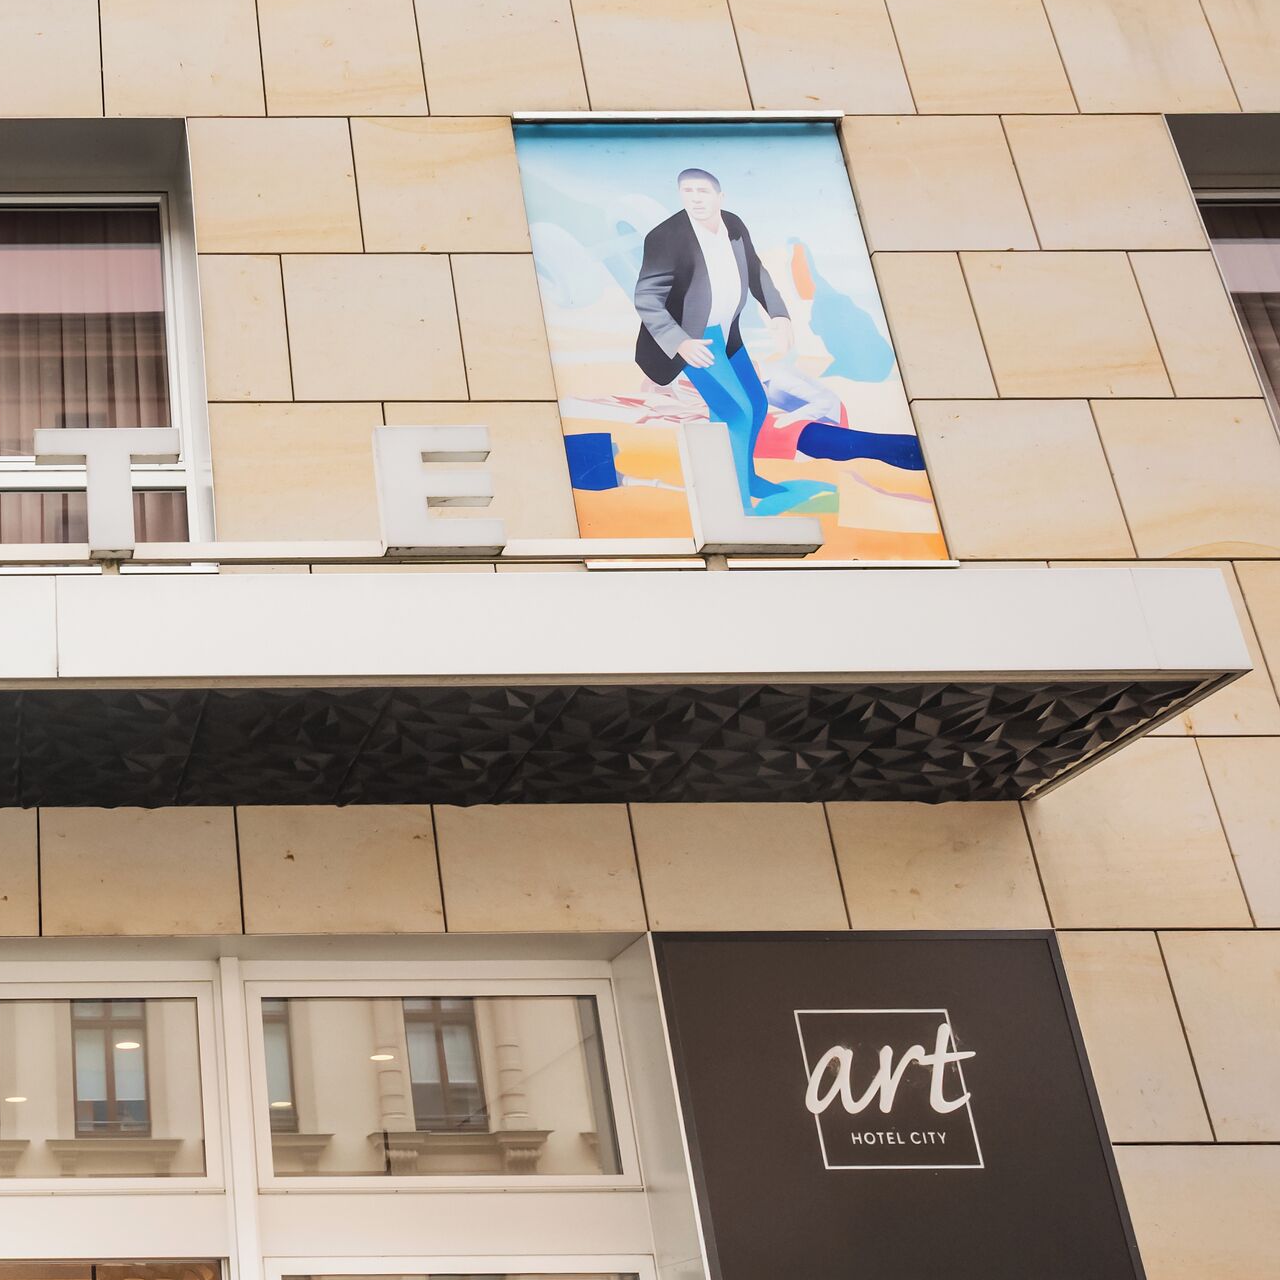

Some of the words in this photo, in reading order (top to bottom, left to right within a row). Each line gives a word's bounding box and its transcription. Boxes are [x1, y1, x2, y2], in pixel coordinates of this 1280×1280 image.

[805, 1023, 976, 1114] art
[851, 1131, 906, 1145] HOTEL
[910, 1131, 946, 1145] CITY
